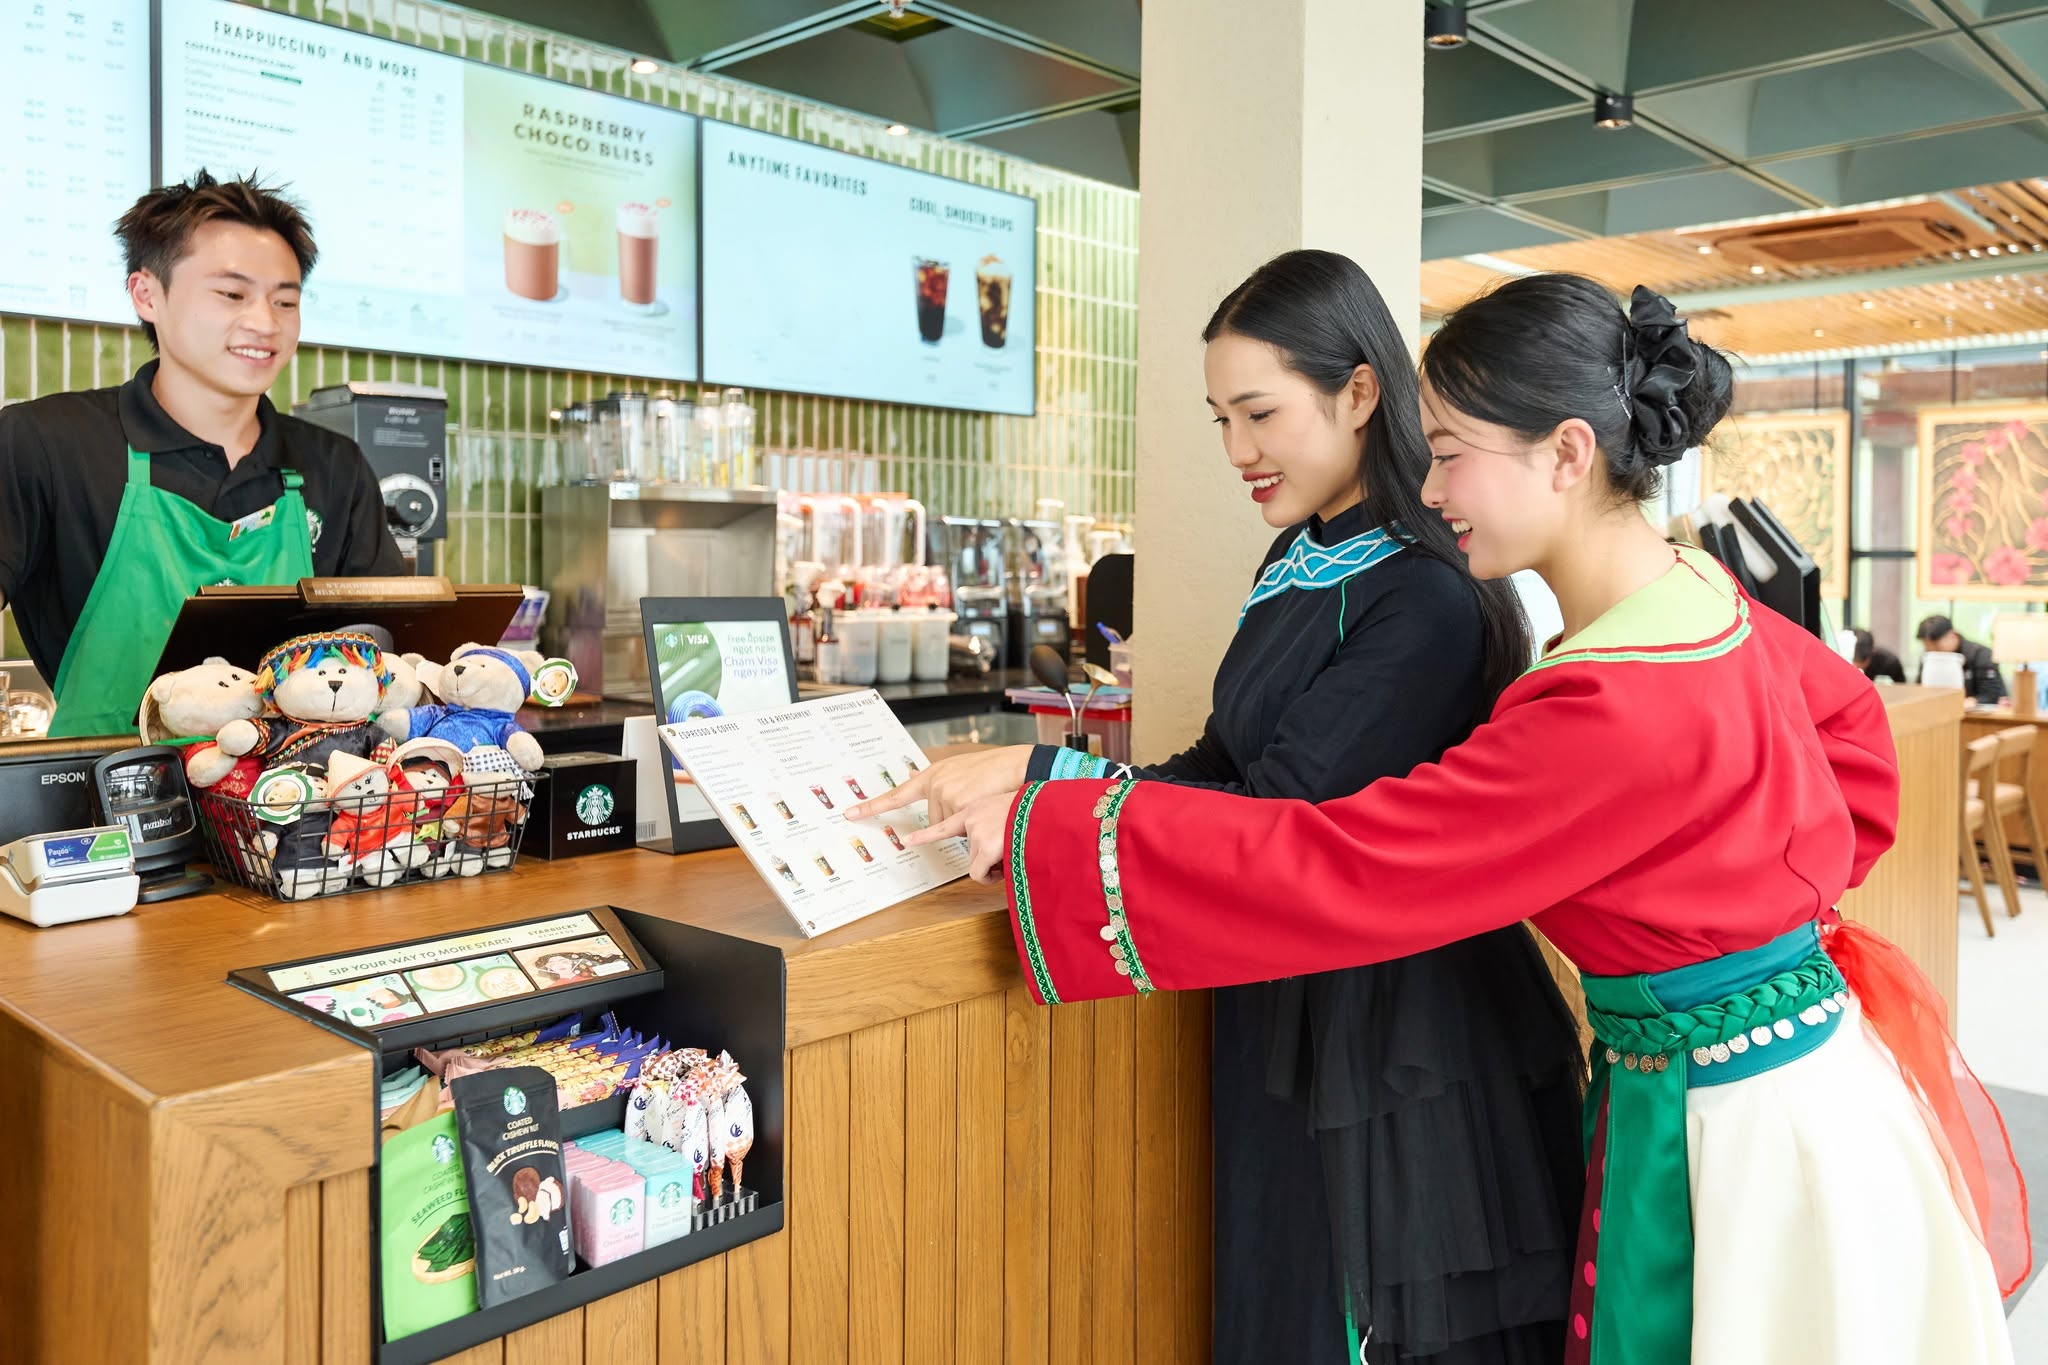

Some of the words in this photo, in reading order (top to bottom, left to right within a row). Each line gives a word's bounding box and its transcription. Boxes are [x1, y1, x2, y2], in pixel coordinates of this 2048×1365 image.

[343, 51, 373, 71] AND
[379, 60, 418, 79] MORE
[523, 103, 647, 143] RASPBERRY
[513, 124, 590, 153] CHOCO
[600, 143, 656, 167] BLISS
[728, 150, 791, 179] ANYTIME
[795, 165, 868, 196] FAVORITES
[944, 205, 987, 226] SMOOTH
[990, 215, 1014, 232] SIPS
[686, 634, 710, 645] VISA
[728, 634, 746, 643] Free
[757, 716, 768, 726] TEA
[678, 728, 711, 740] ESPRESSO
[711, 726, 718, 734] &
[717, 722, 740, 734] COFFEE
[41, 772, 86, 785] EPSON
[143, 817, 172, 831] symbol
[567, 826, 621, 840] STARBUCKS
[48, 847, 69, 857] Payoo
[527, 923, 578, 935] STARBUCKS
[328, 966, 349, 976] SIP
[352, 960, 387, 971] YOUR
[389, 954, 417, 964] WAY
[419, 951, 436, 959] TO
[437, 943, 473, 956] MORE
[474, 937, 513, 949] STARS!
[507, 1116, 534, 1130] COATED
[502, 1126, 529, 1141] CASHEW
[505, 1140, 537, 1157] TRUFFLE
[411, 1191, 453, 1224] SEAWEED
